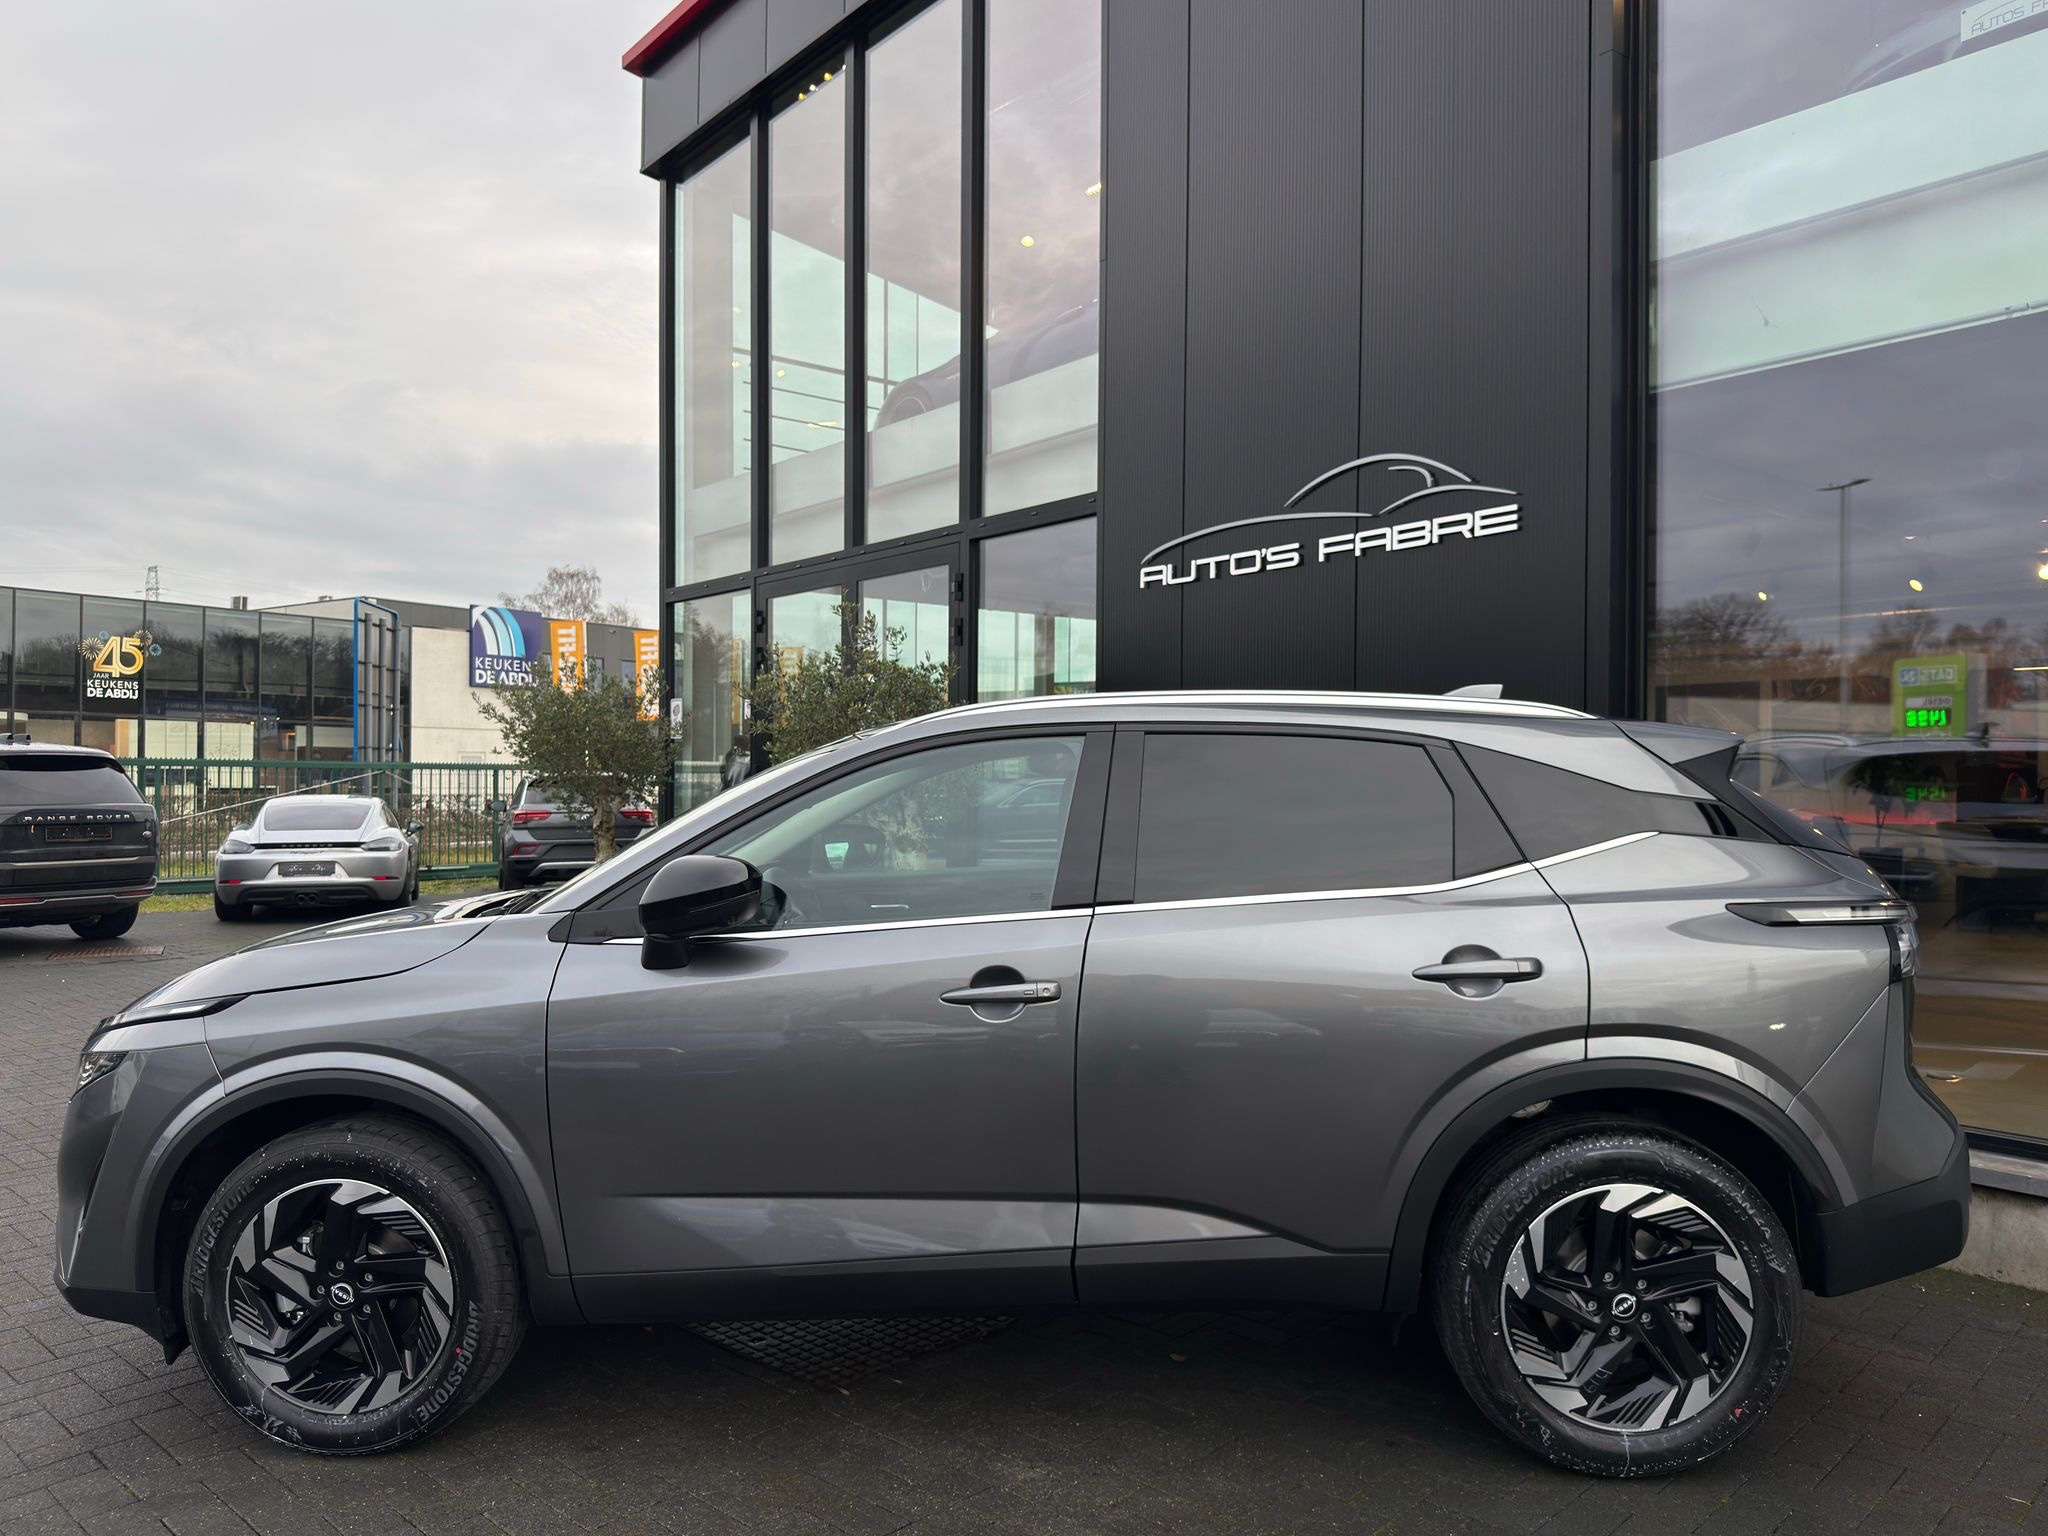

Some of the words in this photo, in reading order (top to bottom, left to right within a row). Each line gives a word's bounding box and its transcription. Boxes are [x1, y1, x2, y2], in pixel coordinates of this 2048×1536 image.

[1139, 542, 1300, 589] AUTO'S
[1318, 503, 1519, 563] FABRE
[93, 635, 145, 678] 45
[475, 657, 538, 672] KEUKEN
[93, 672, 110, 680] JAAR
[475, 669, 496, 684] DE
[86, 679, 139, 690] KEUKENS
[86, 687, 104, 698] DE
[104, 688, 139, 700] ABDIJ
[23, 814, 77, 824] RANGE
[86, 813, 131, 822] ROVER
[416, 1299, 482, 1422] BRIDGESTONE
